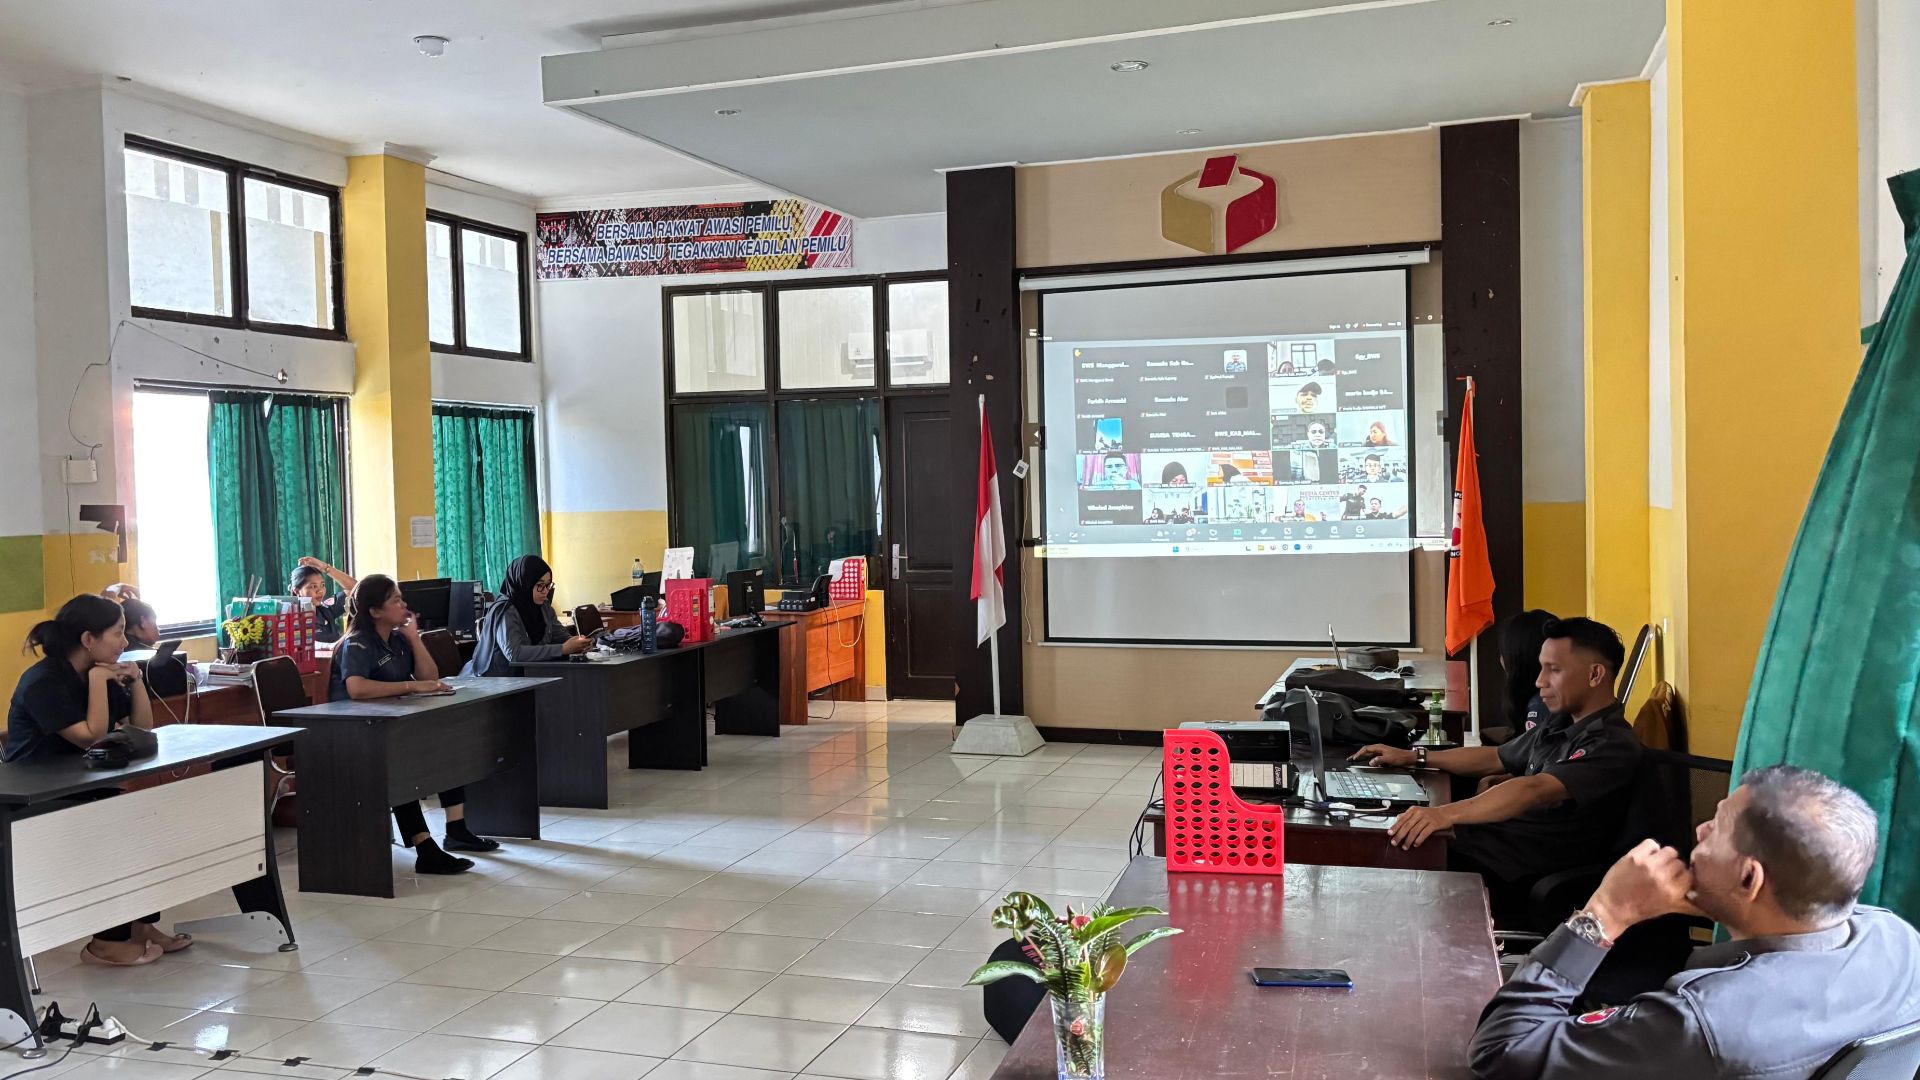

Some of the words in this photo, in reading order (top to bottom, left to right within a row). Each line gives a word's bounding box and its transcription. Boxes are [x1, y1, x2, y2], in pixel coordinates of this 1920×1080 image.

[596, 220, 653, 241] BERSAMA
[655, 218, 703, 238] RAKYAT
[704, 216, 745, 236] AWASI
[548, 245, 606, 264] BERSAMA
[606, 243, 664, 262] BAWASLU
[668, 240, 737, 260] TEGAKKAN
[737, 238, 799, 258] KEADILAN
[800, 235, 847, 254] PEMILU
